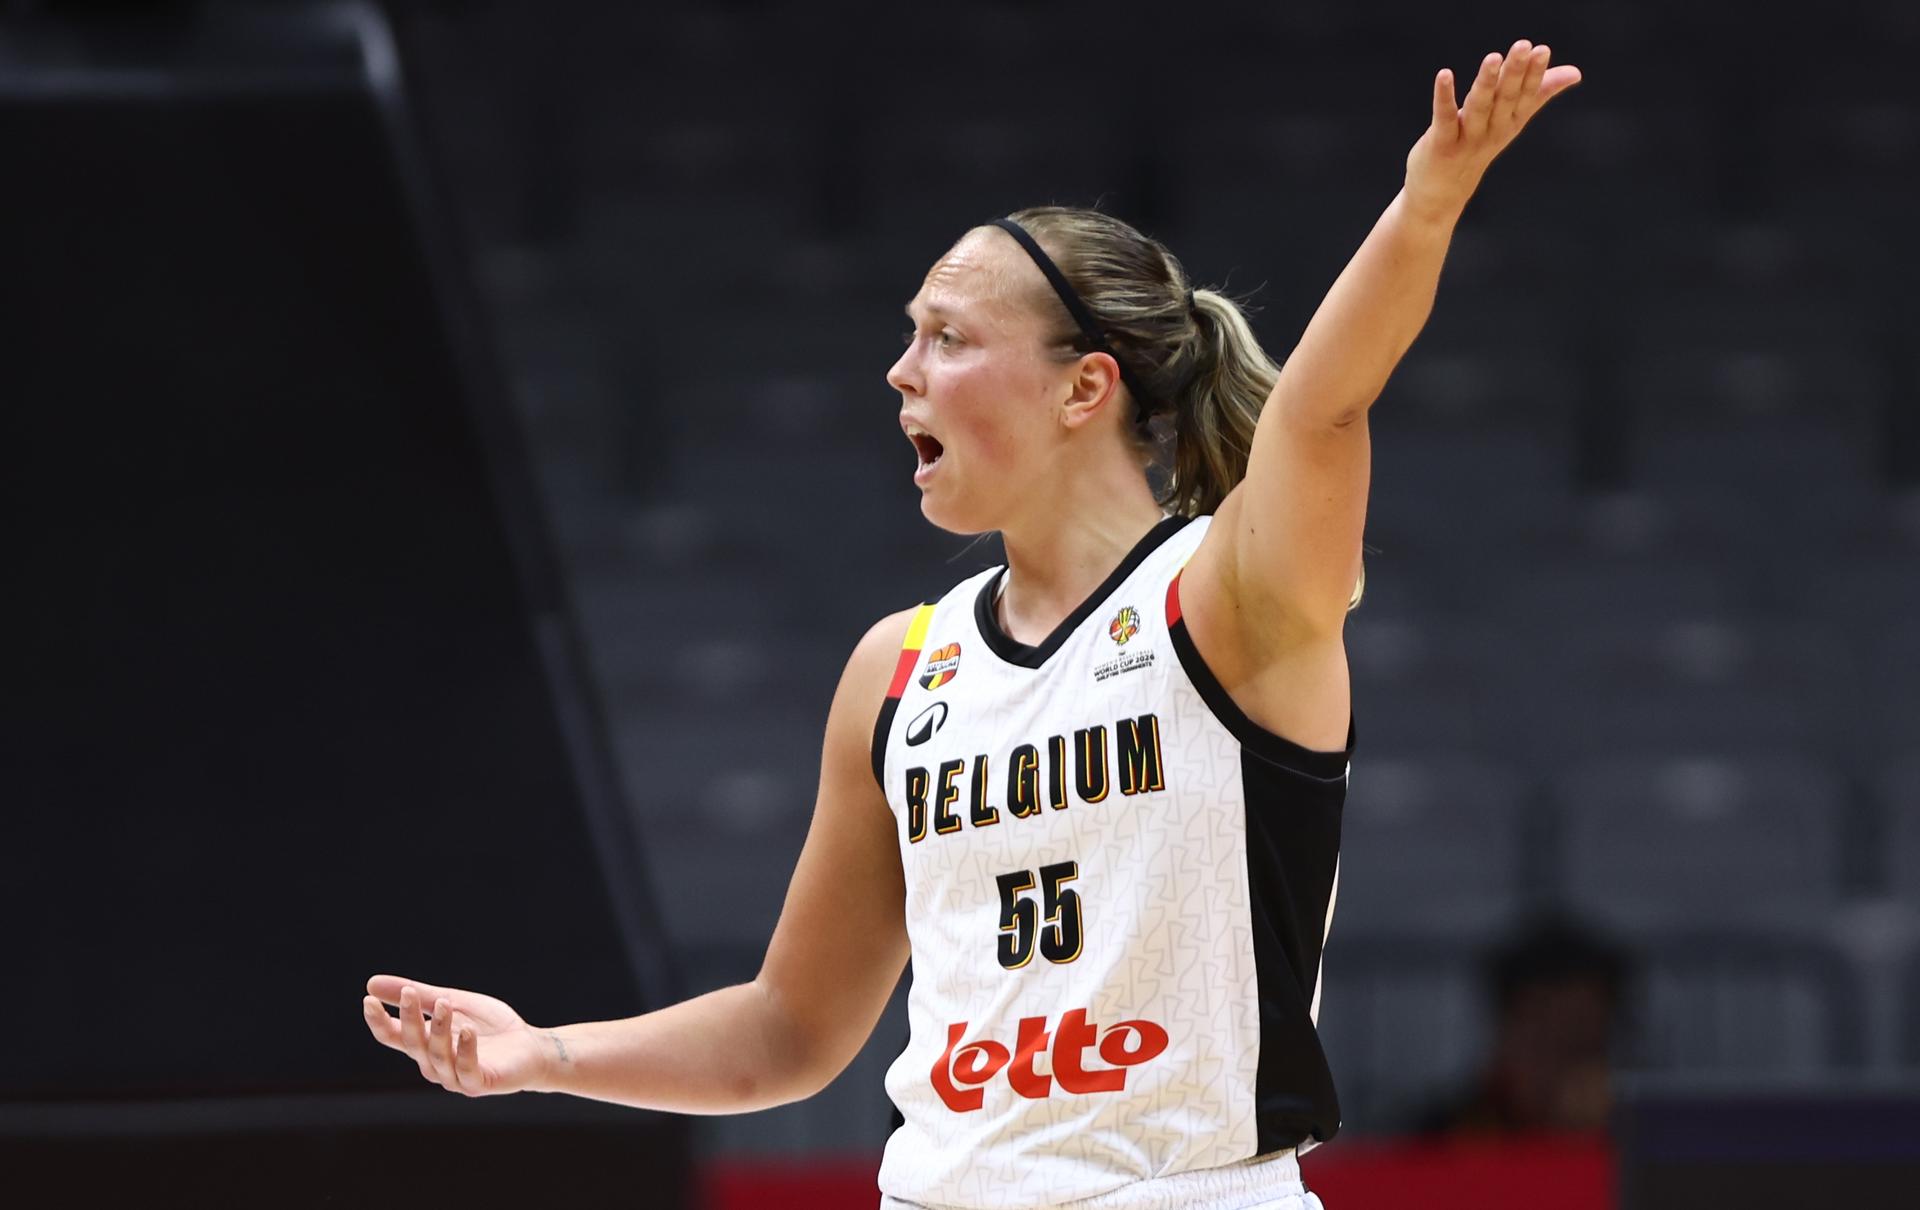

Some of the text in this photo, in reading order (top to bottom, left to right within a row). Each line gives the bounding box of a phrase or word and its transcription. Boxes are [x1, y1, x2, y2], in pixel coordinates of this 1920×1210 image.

[1094, 664, 1118, 677] WORLD
[1120, 659, 1133, 668] CUP
[1136, 654, 1155, 663] 2026
[906, 714, 1165, 843] BELGIUM
[995, 860, 1084, 970] 55
